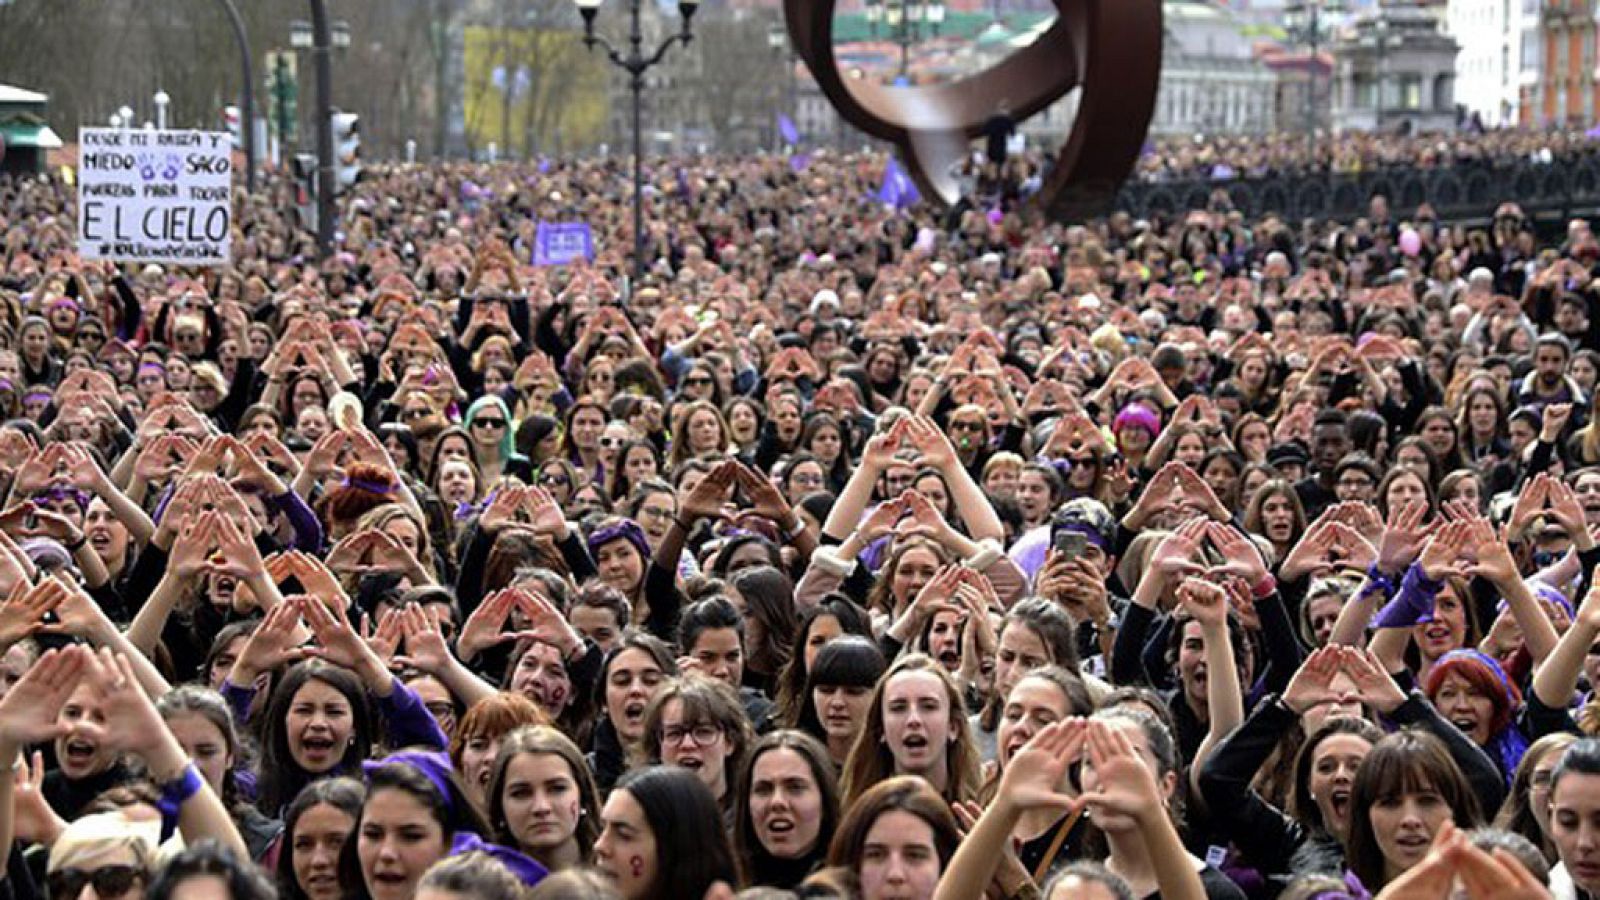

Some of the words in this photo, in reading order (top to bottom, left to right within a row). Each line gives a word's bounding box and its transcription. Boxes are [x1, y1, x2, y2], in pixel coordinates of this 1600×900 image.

[130, 133, 147, 146] MI
[210, 135, 221, 148] Y
[84, 153, 135, 171] MIEDO
[185, 153, 229, 174] SACO
[142, 205, 229, 242] CIELO
